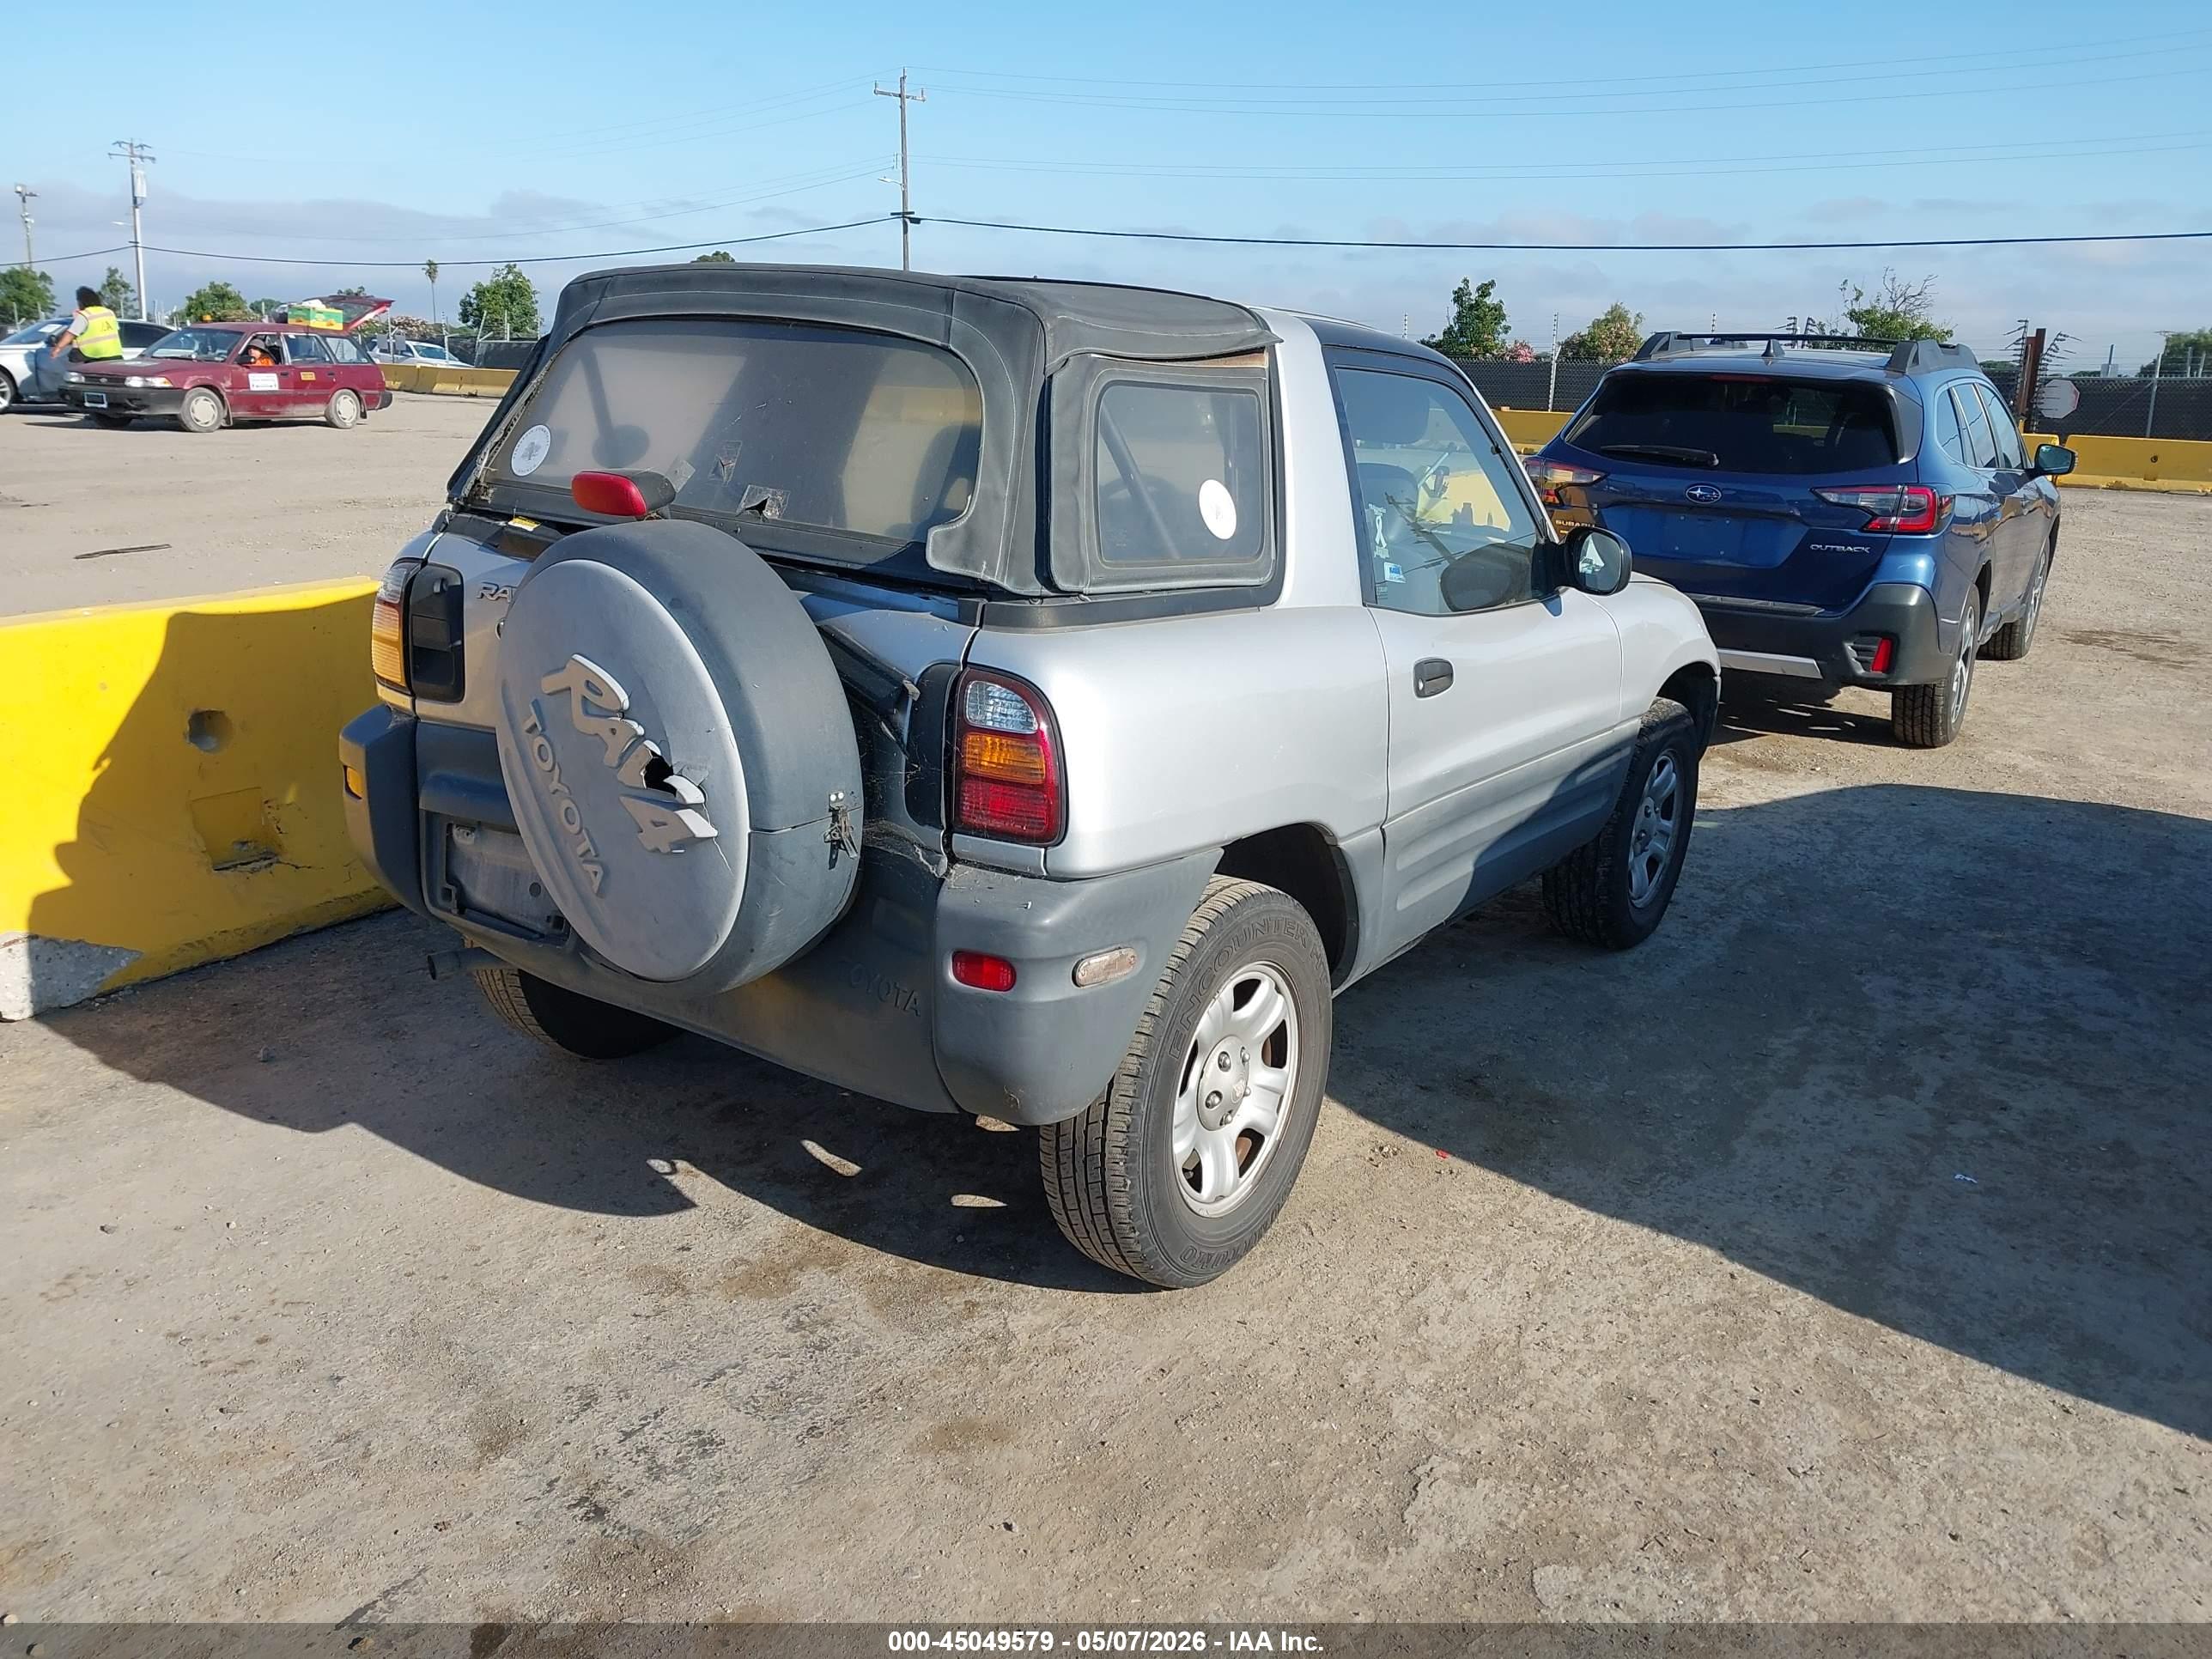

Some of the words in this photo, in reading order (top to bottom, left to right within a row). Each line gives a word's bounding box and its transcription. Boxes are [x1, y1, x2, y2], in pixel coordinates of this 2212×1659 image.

[1809, 544, 1871, 554] OUTBACK
[522, 697, 605, 895] TOYOTA
[1169, 915, 1307, 1060] ENCOUNTER
